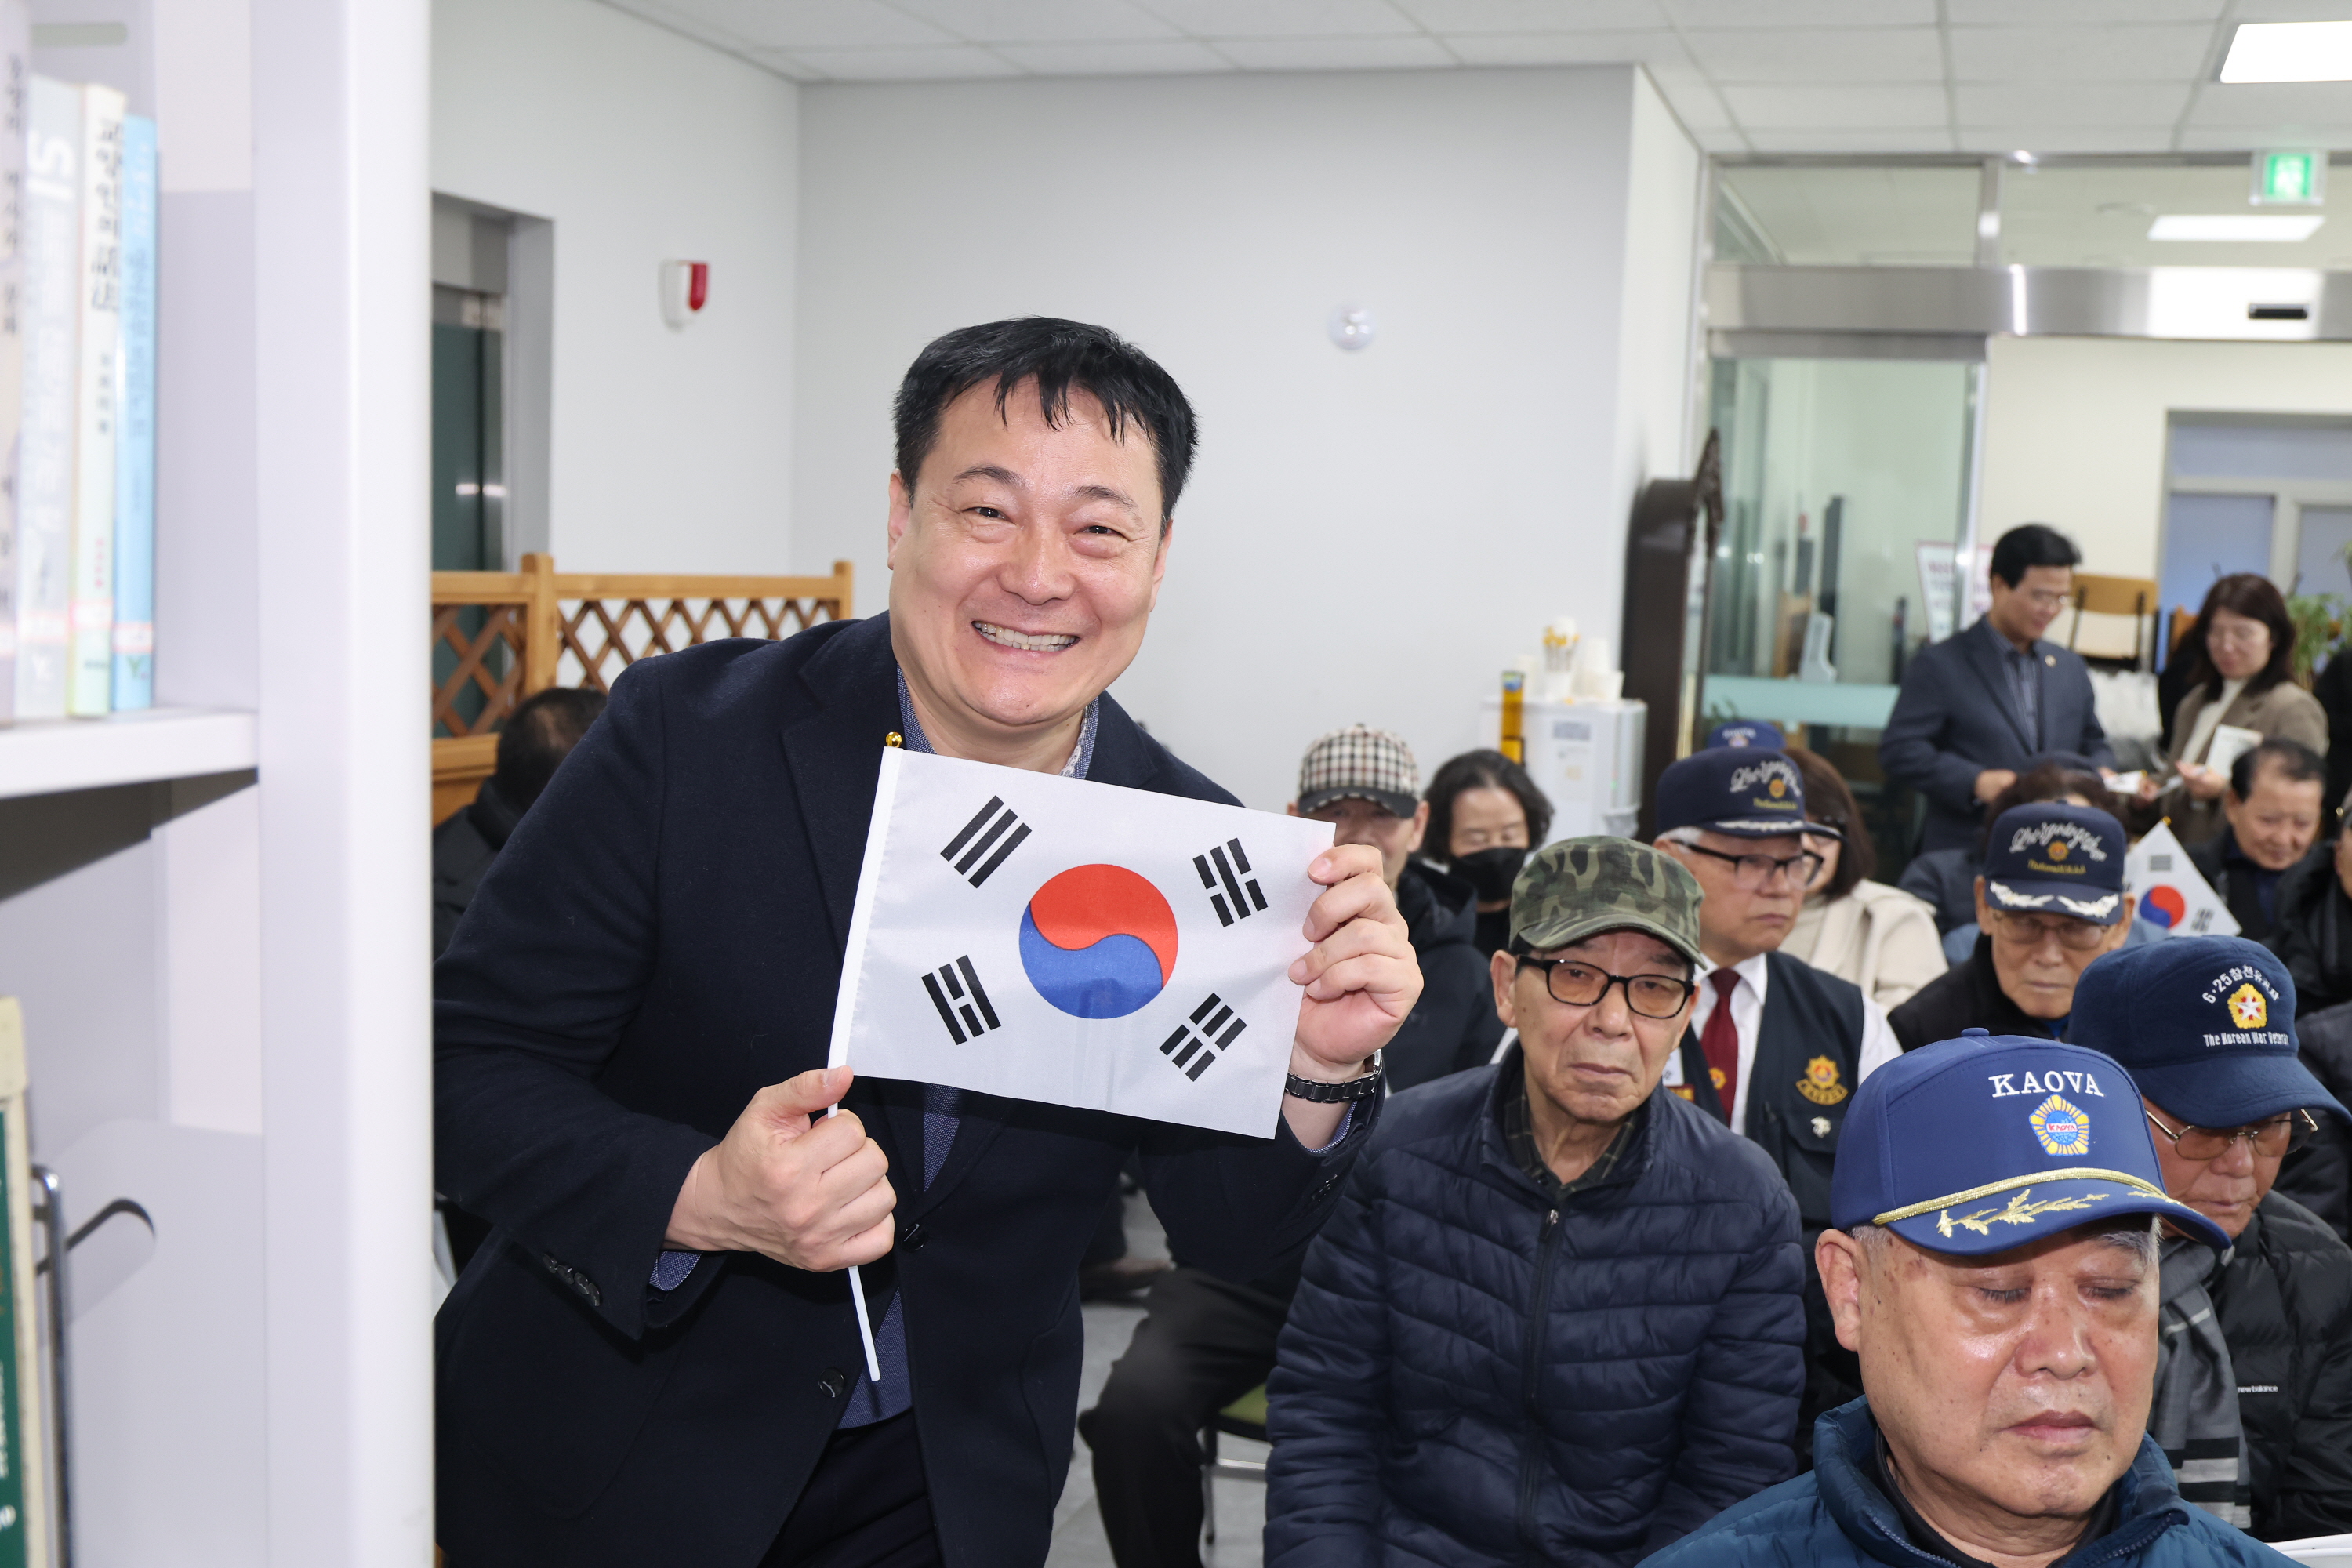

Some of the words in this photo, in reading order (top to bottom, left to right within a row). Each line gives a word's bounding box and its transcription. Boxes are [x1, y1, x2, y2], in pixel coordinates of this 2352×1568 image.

[2203, 1034, 2220, 1047] The
[2220, 1033, 2252, 1045] Korean
[2251, 1032, 2267, 1044] War
[1988, 1070, 2105, 1098] KAOVA
